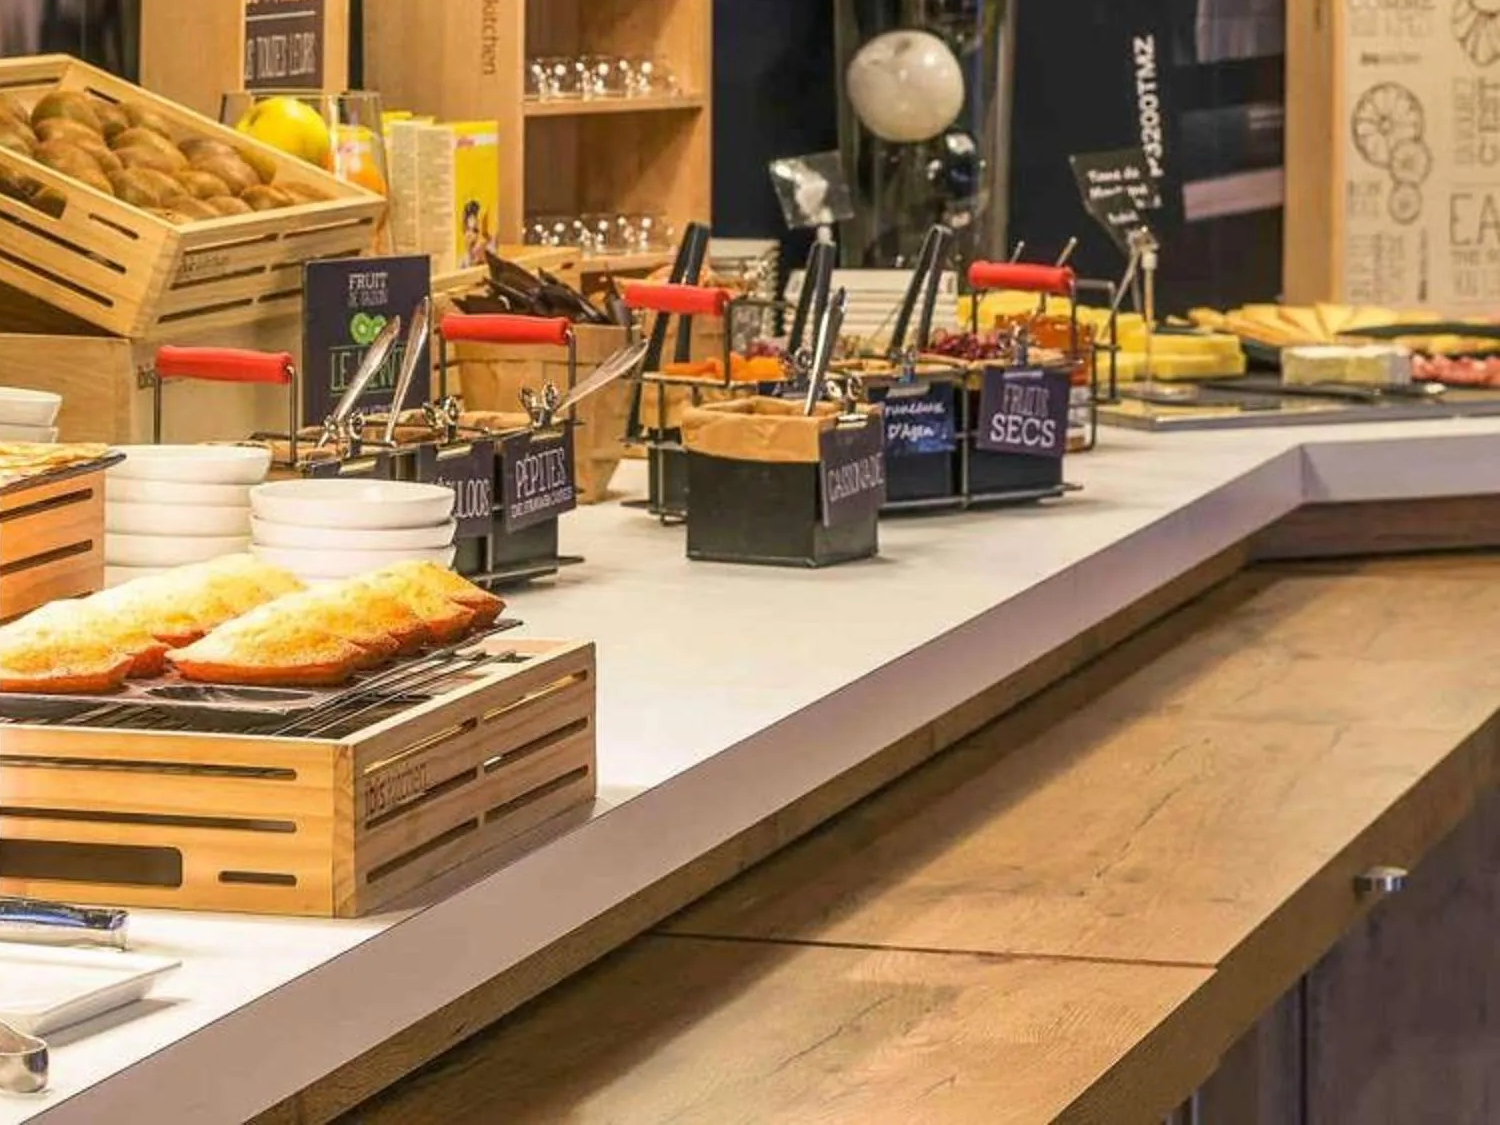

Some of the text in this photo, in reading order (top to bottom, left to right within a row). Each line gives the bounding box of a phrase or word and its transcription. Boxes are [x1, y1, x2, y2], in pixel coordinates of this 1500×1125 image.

[348, 272, 388, 290] FRUIT
[989, 413, 1056, 448] SECS
[515, 446, 565, 499] PÉPITES
